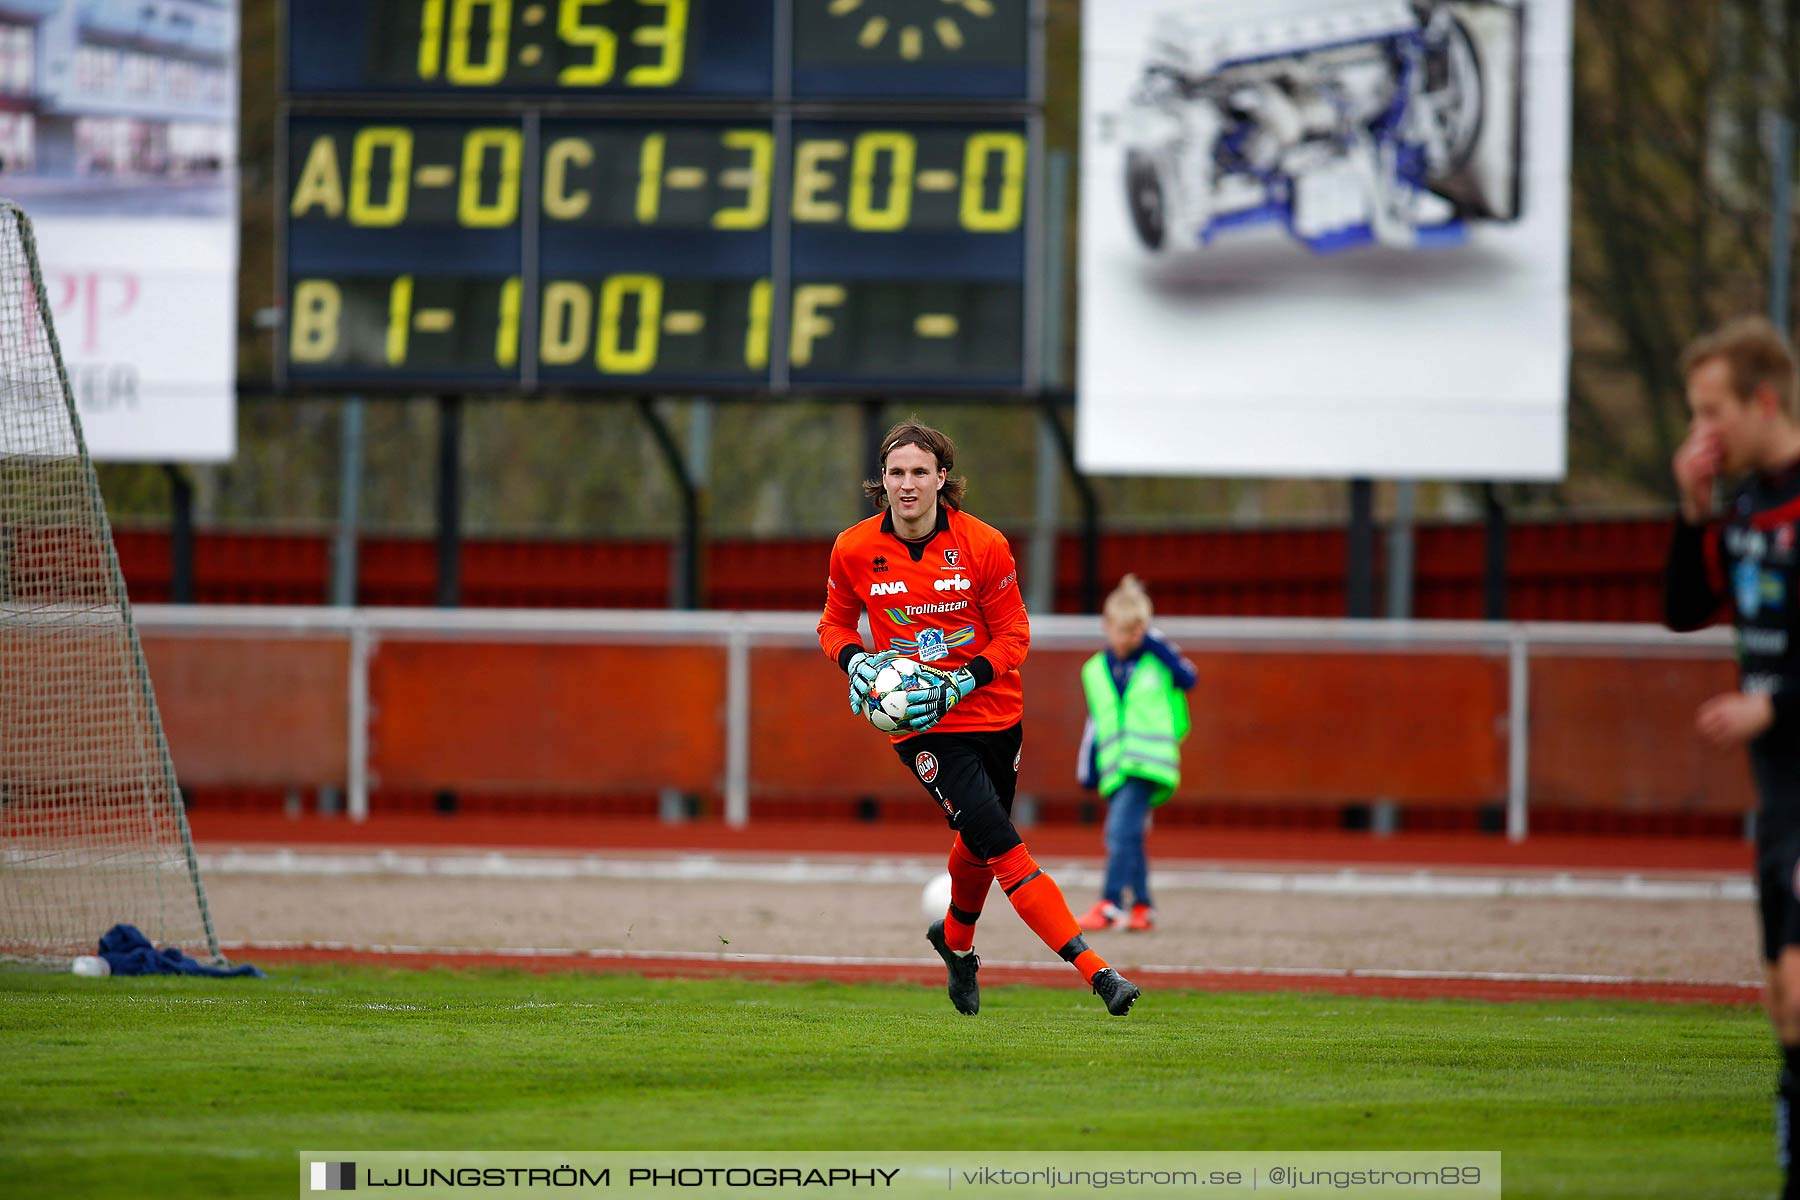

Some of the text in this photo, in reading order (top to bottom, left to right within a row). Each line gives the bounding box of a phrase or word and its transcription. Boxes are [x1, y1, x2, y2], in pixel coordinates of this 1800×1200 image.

[418, 0, 690, 86] 10:53
[790, 284, 846, 367] F
[870, 580, 909, 596] ANA
[904, 600, 968, 616] Trollhättan
[918, 757, 935, 776] OLW
